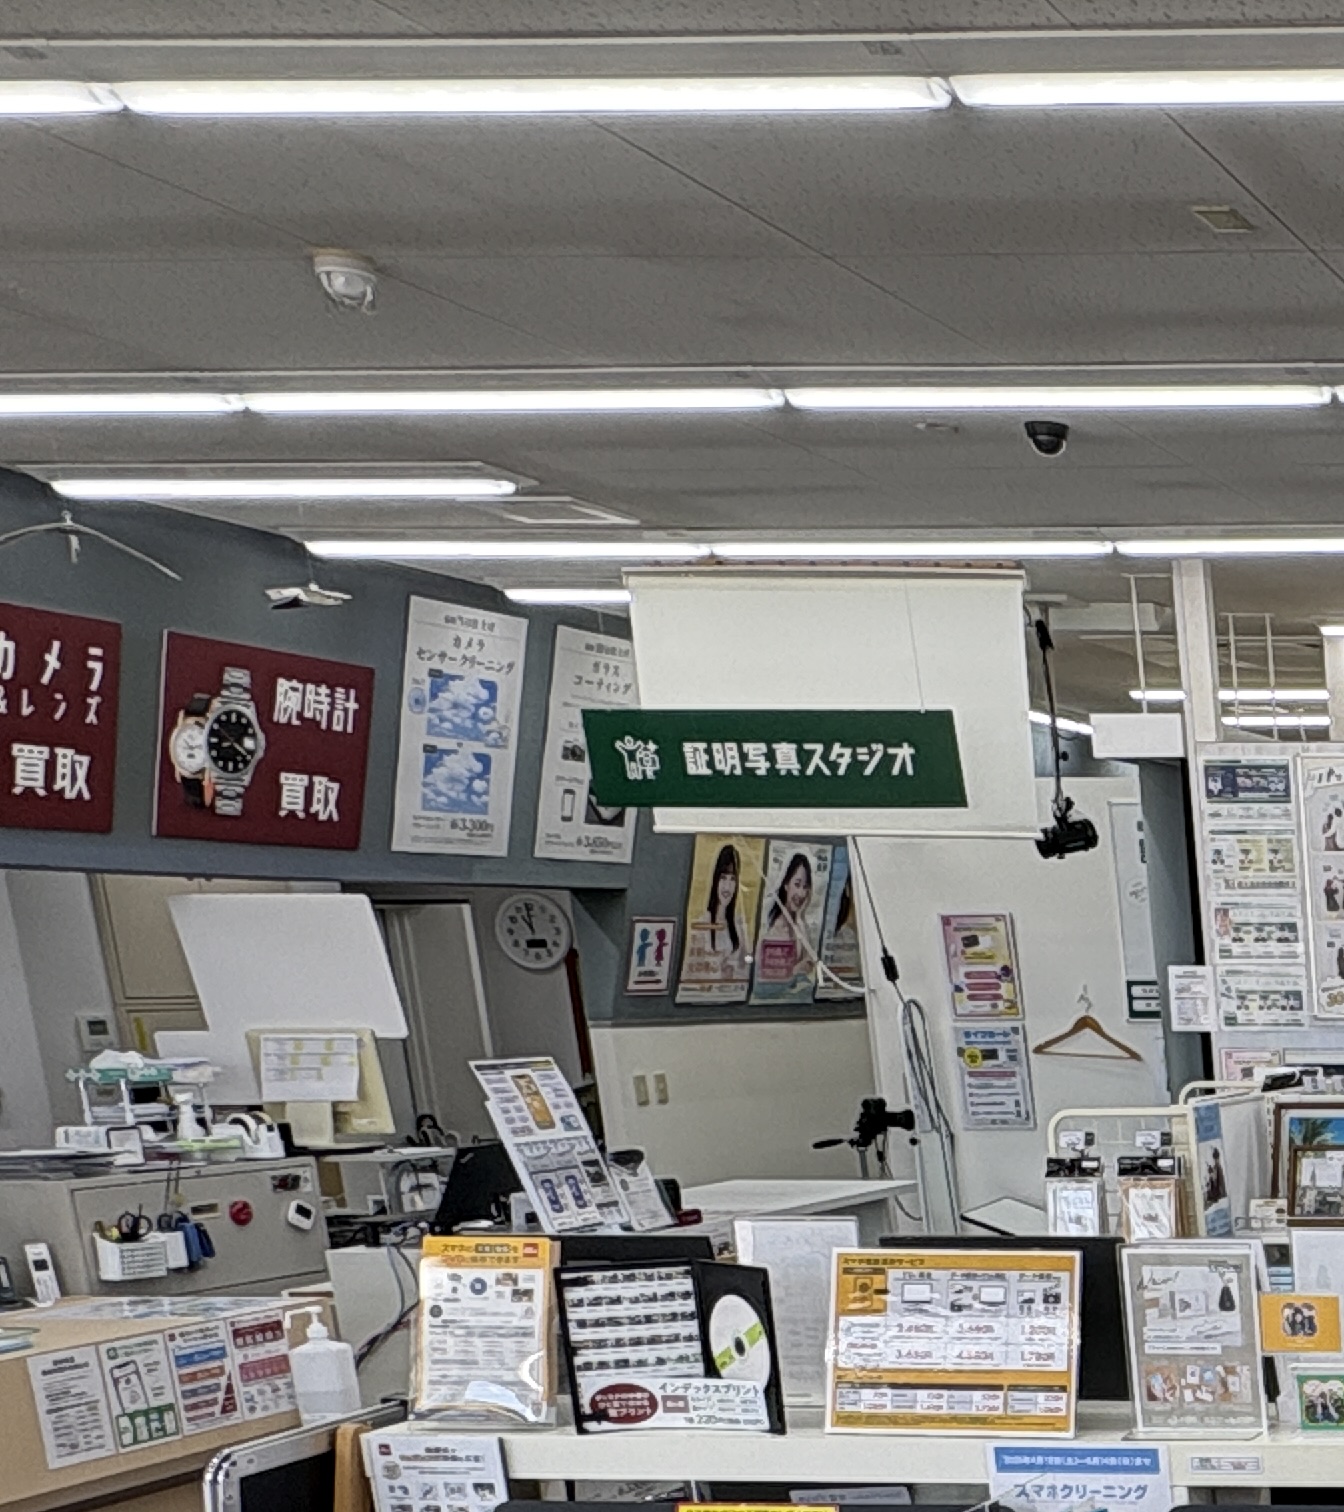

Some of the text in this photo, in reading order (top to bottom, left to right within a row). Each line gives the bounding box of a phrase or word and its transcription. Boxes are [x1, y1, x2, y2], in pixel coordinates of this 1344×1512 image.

[416, 647, 516, 675] センサークリーニング
[273, 677, 359, 734] 腕時計
[11, 743, 91, 801] 買取
[682, 742, 916, 778] 証明写真スタジオ
[279, 772, 340, 822] 買取
[658, 1382, 760, 1398] インデックスプリント
[1013, 1484, 1149, 1500] スマホクリーニング
